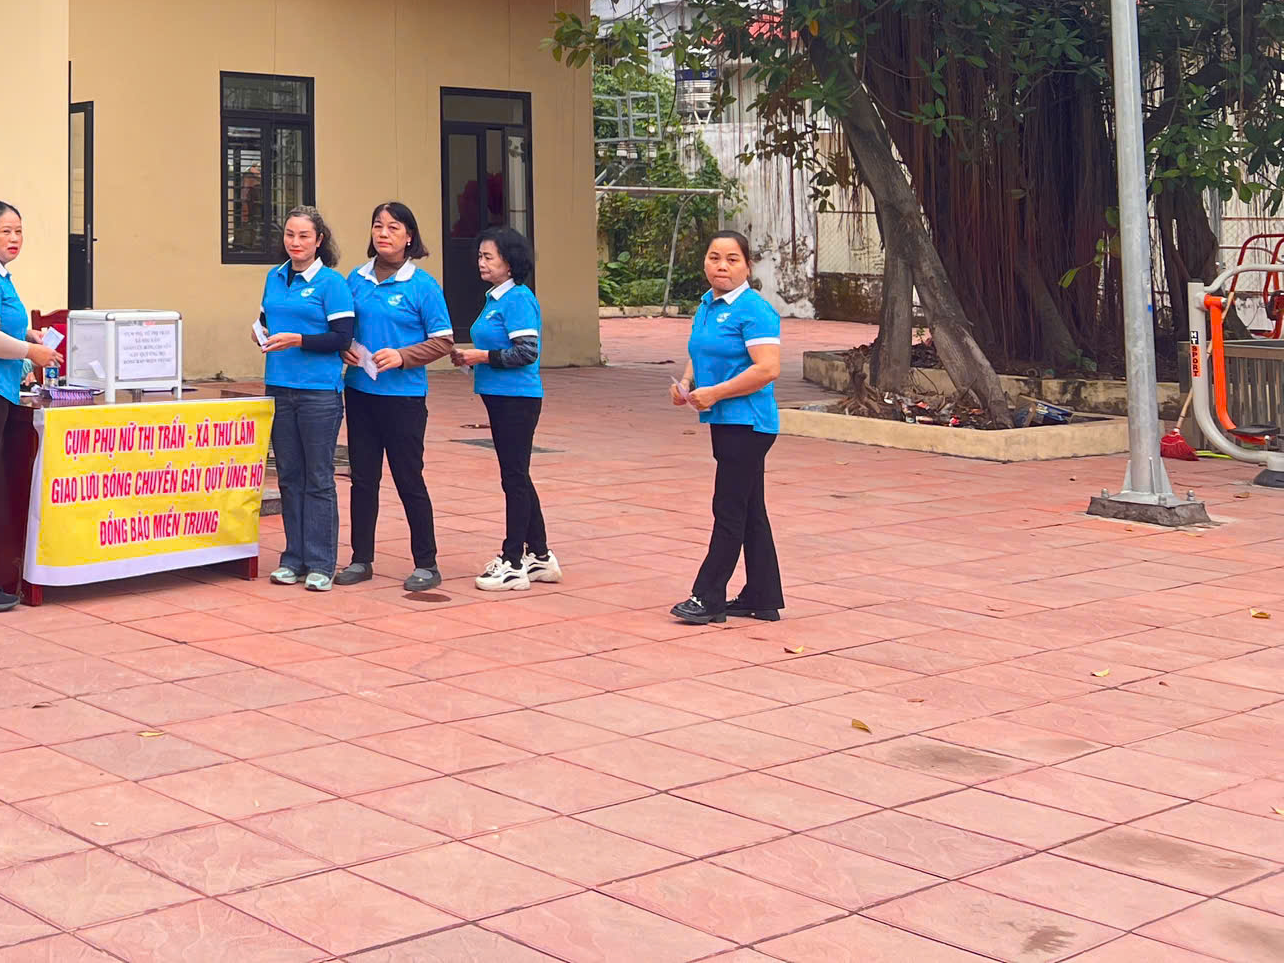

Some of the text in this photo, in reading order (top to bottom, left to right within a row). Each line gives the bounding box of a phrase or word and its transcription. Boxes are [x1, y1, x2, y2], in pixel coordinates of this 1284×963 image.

[65, 429, 90, 460] CỤM
[93, 428, 116, 458] PHỤ
[119, 422, 136, 452] NỮ
[138, 426, 155, 456] THỊ
[158, 416, 185, 449] TRẤN
[196, 418, 210, 448] XÃ
[213, 421, 234, 446] THƯ
[235, 416, 255, 445] LÂM
[51, 477, 77, 503] GIAO
[81, 473, 100, 501] LƯU
[102, 468, 132, 498] BÓNG
[181, 463, 202, 493] GÂY
[204, 461, 224, 493] QUỸ
[249, 458, 264, 491] HỘ
[130, 510, 150, 542] BÀO
[183, 510, 219, 536] TRUNG
